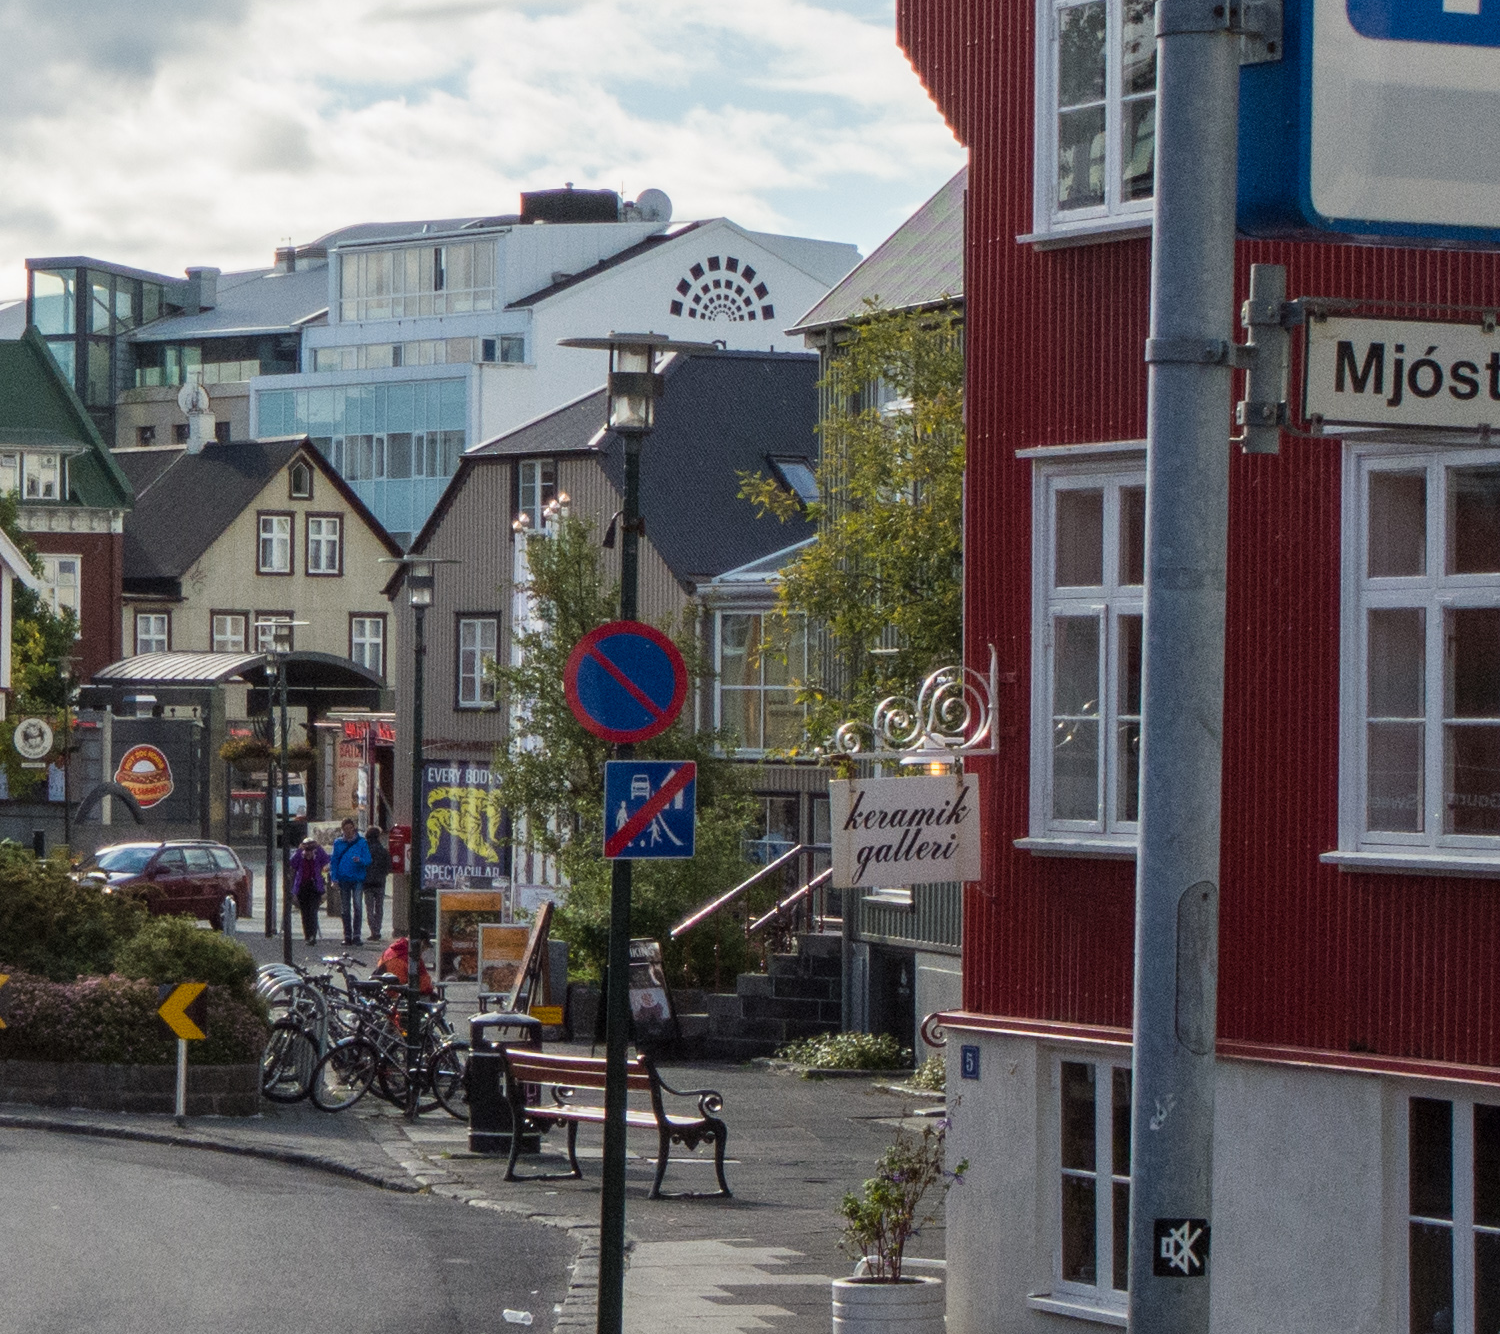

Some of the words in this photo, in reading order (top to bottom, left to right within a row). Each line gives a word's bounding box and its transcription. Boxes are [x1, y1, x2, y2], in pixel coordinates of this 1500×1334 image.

[428, 768, 461, 783] EVERY
[843, 786, 971, 830] keramik
[852, 828, 959, 885] galleri
[424, 865, 499, 882] SPECTACULAR
[966, 1052, 974, 1072] 5
